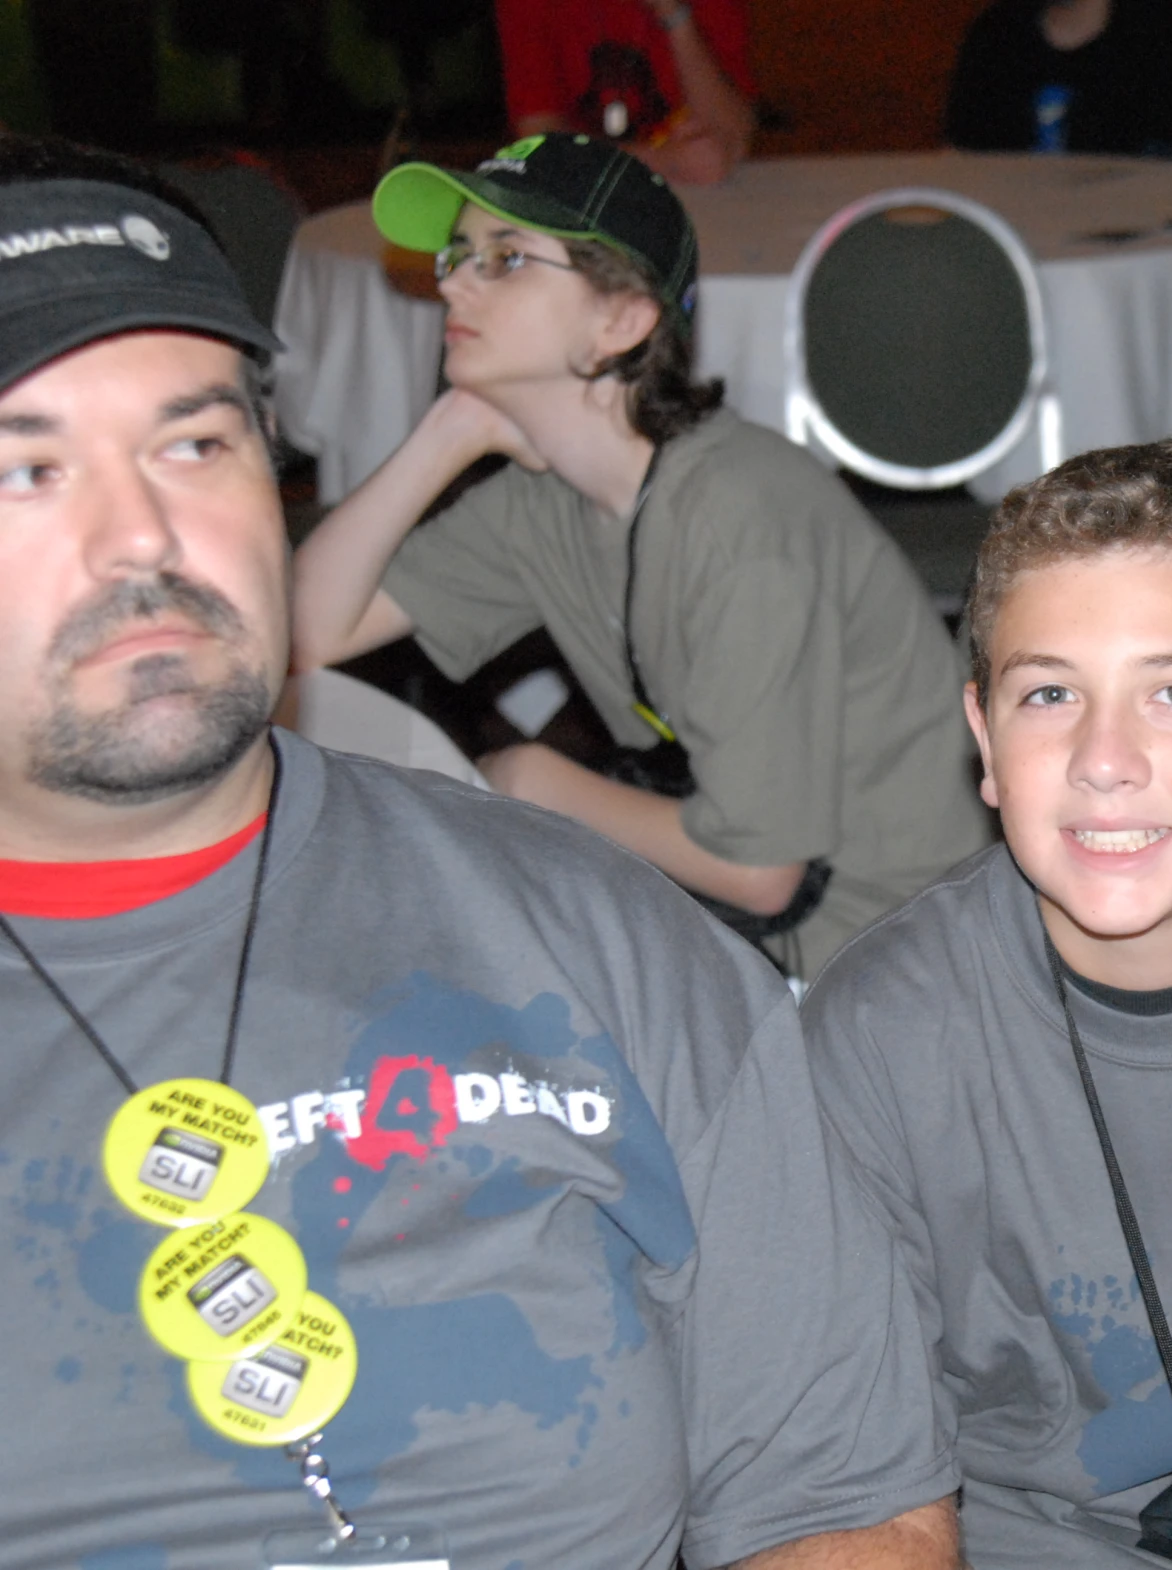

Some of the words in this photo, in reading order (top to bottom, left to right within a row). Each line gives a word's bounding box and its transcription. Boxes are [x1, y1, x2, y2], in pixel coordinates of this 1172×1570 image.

[148, 1100, 179, 1118] MY
[182, 1112, 258, 1147] MATCH?
[167, 1089, 207, 1109] ARE
[212, 1103, 251, 1126] YOU
[258, 1090, 366, 1152] EFT
[150, 1155, 206, 1191] SLI
[155, 1250, 190, 1280] ARE
[188, 1220, 226, 1248] YOU
[155, 1276, 181, 1301] MY
[183, 1222, 251, 1277] MATCH?
[212, 1277, 265, 1325] SLI
[281, 1329, 344, 1361] ATCH?
[298, 1312, 337, 1336] YOU
[233, 1367, 289, 1406] SLI
